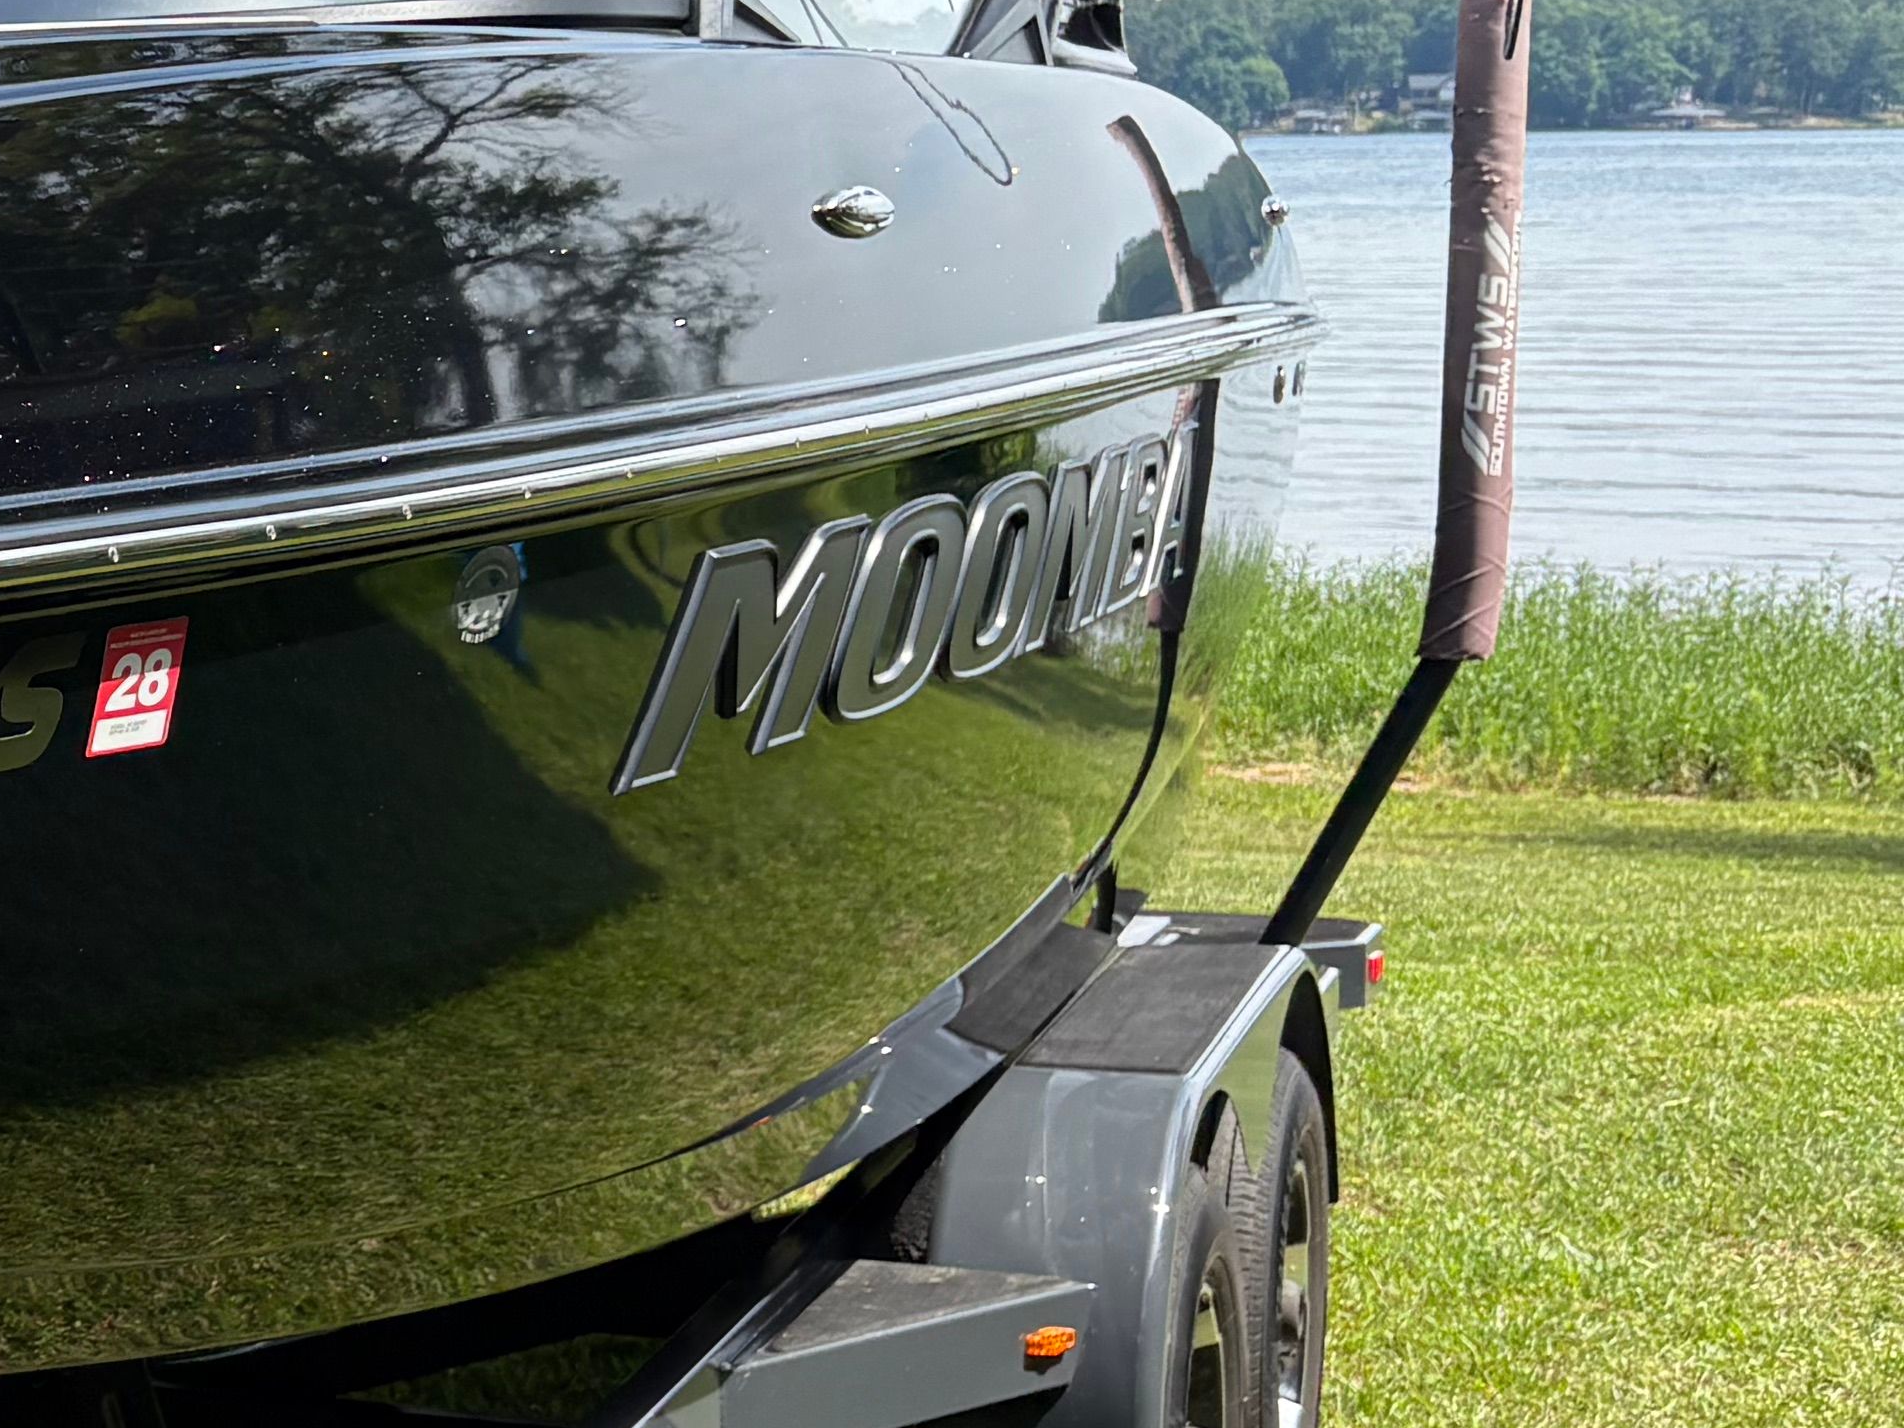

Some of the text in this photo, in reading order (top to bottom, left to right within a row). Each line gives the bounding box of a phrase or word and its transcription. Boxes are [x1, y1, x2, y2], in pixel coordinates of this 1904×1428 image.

[1465, 273, 1509, 414] STWS
[1489, 357, 1512, 477] SOUTHTOWN
[608, 421, 1199, 797] MOOMBA
[104, 647, 172, 713] 28
